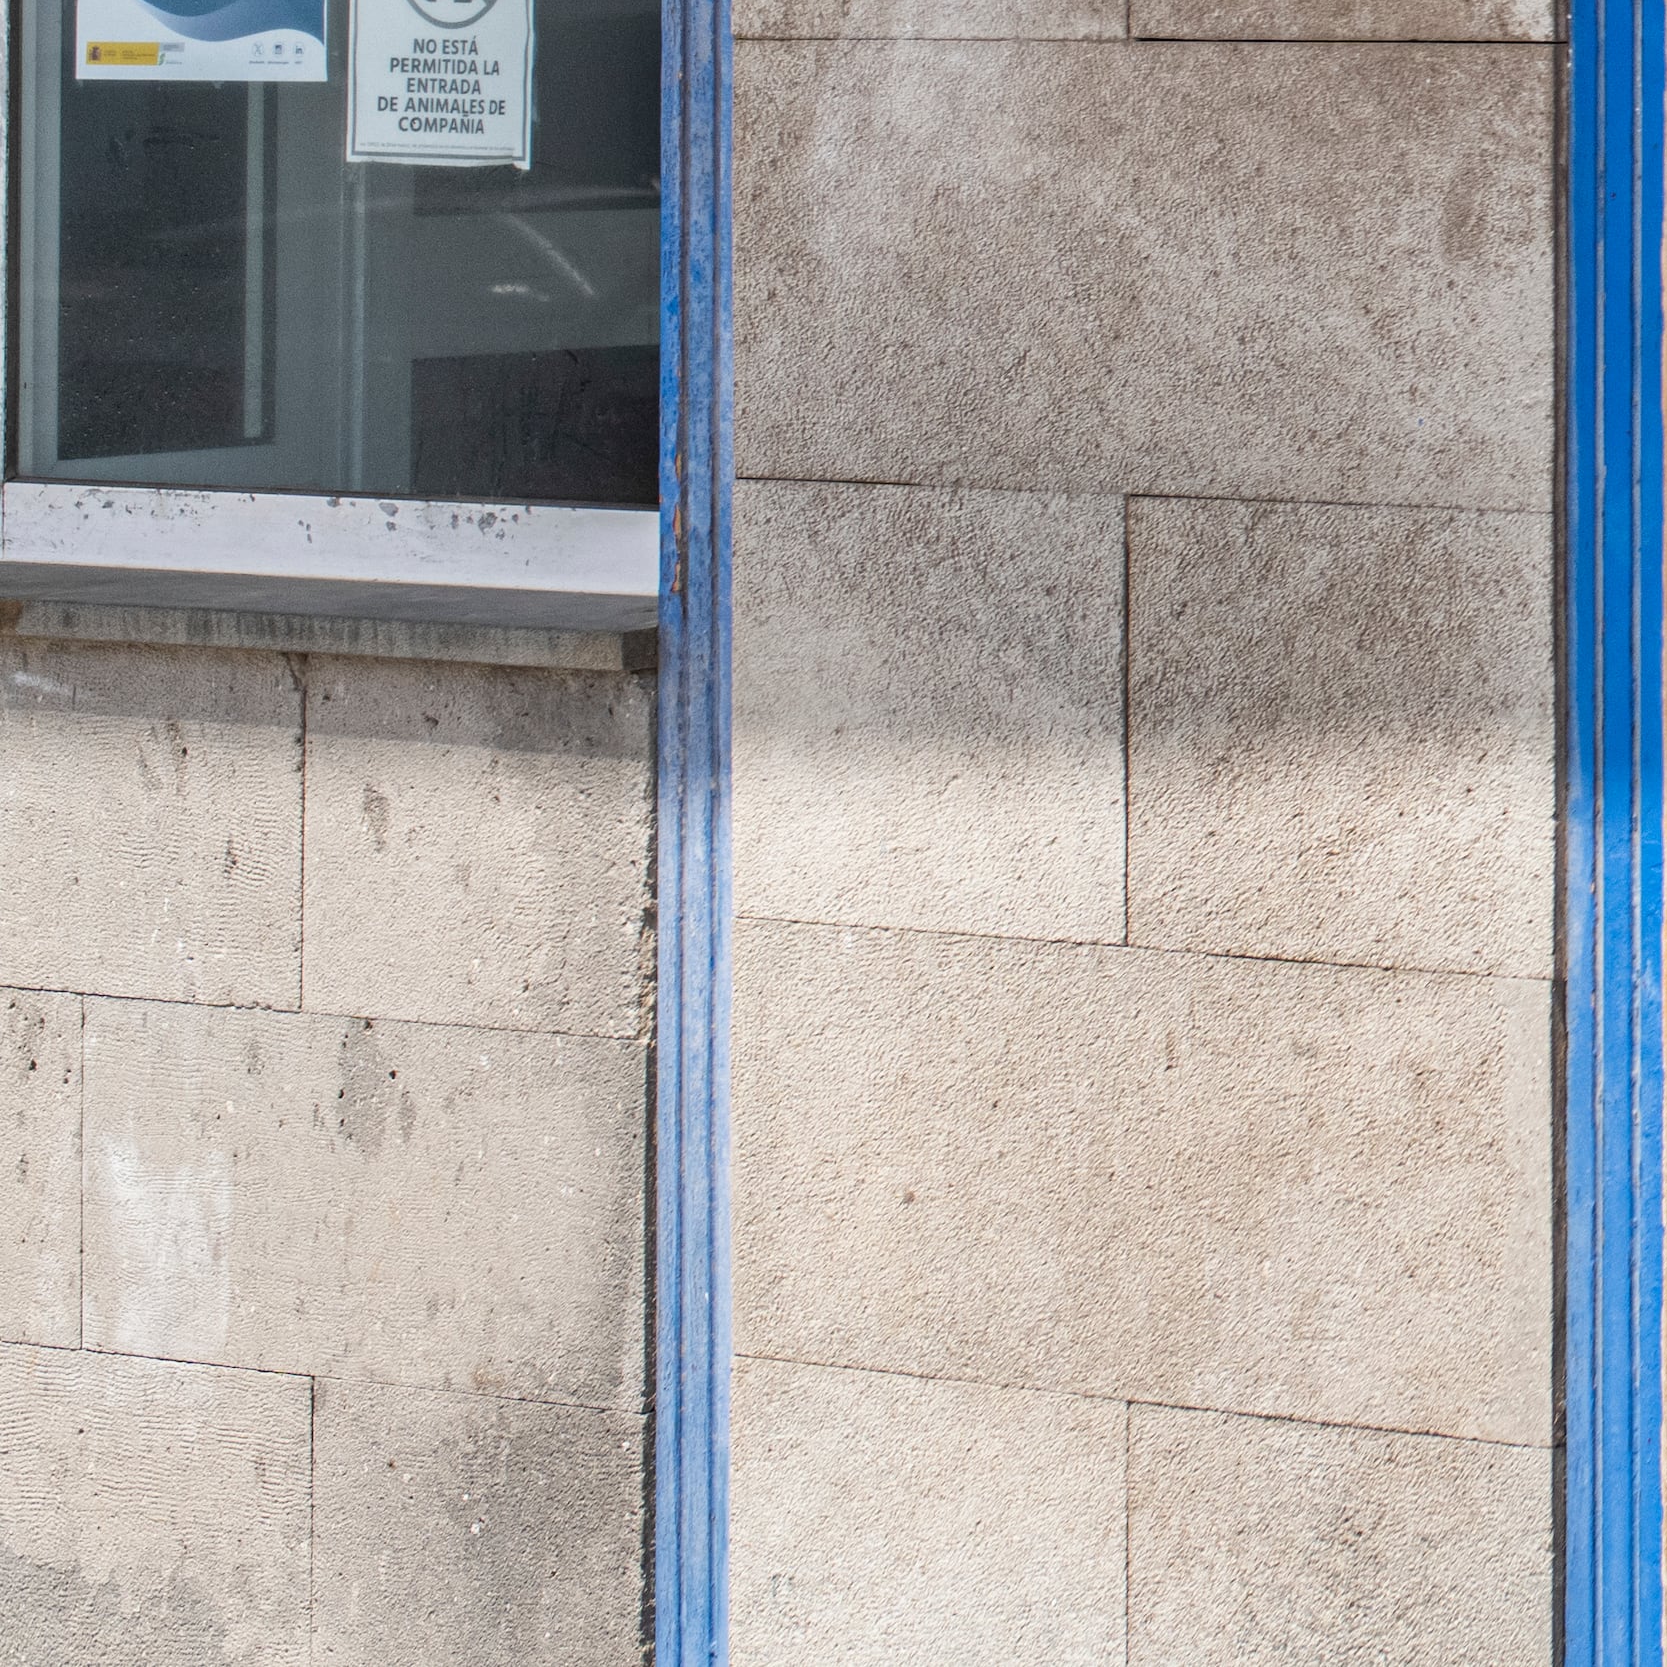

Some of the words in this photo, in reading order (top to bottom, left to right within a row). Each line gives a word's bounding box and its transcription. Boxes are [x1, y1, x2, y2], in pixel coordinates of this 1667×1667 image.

[413, 38, 437, 54] NO
[442, 36, 479, 56] ESTÁ
[390, 57, 479, 75] PERMITIDA
[483, 59, 500, 75] LA
[407, 78, 482, 95] ENTRADA
[377, 96, 398, 112] DE
[404, 98, 485, 115] ANIMALES
[489, 100, 506, 115] DE
